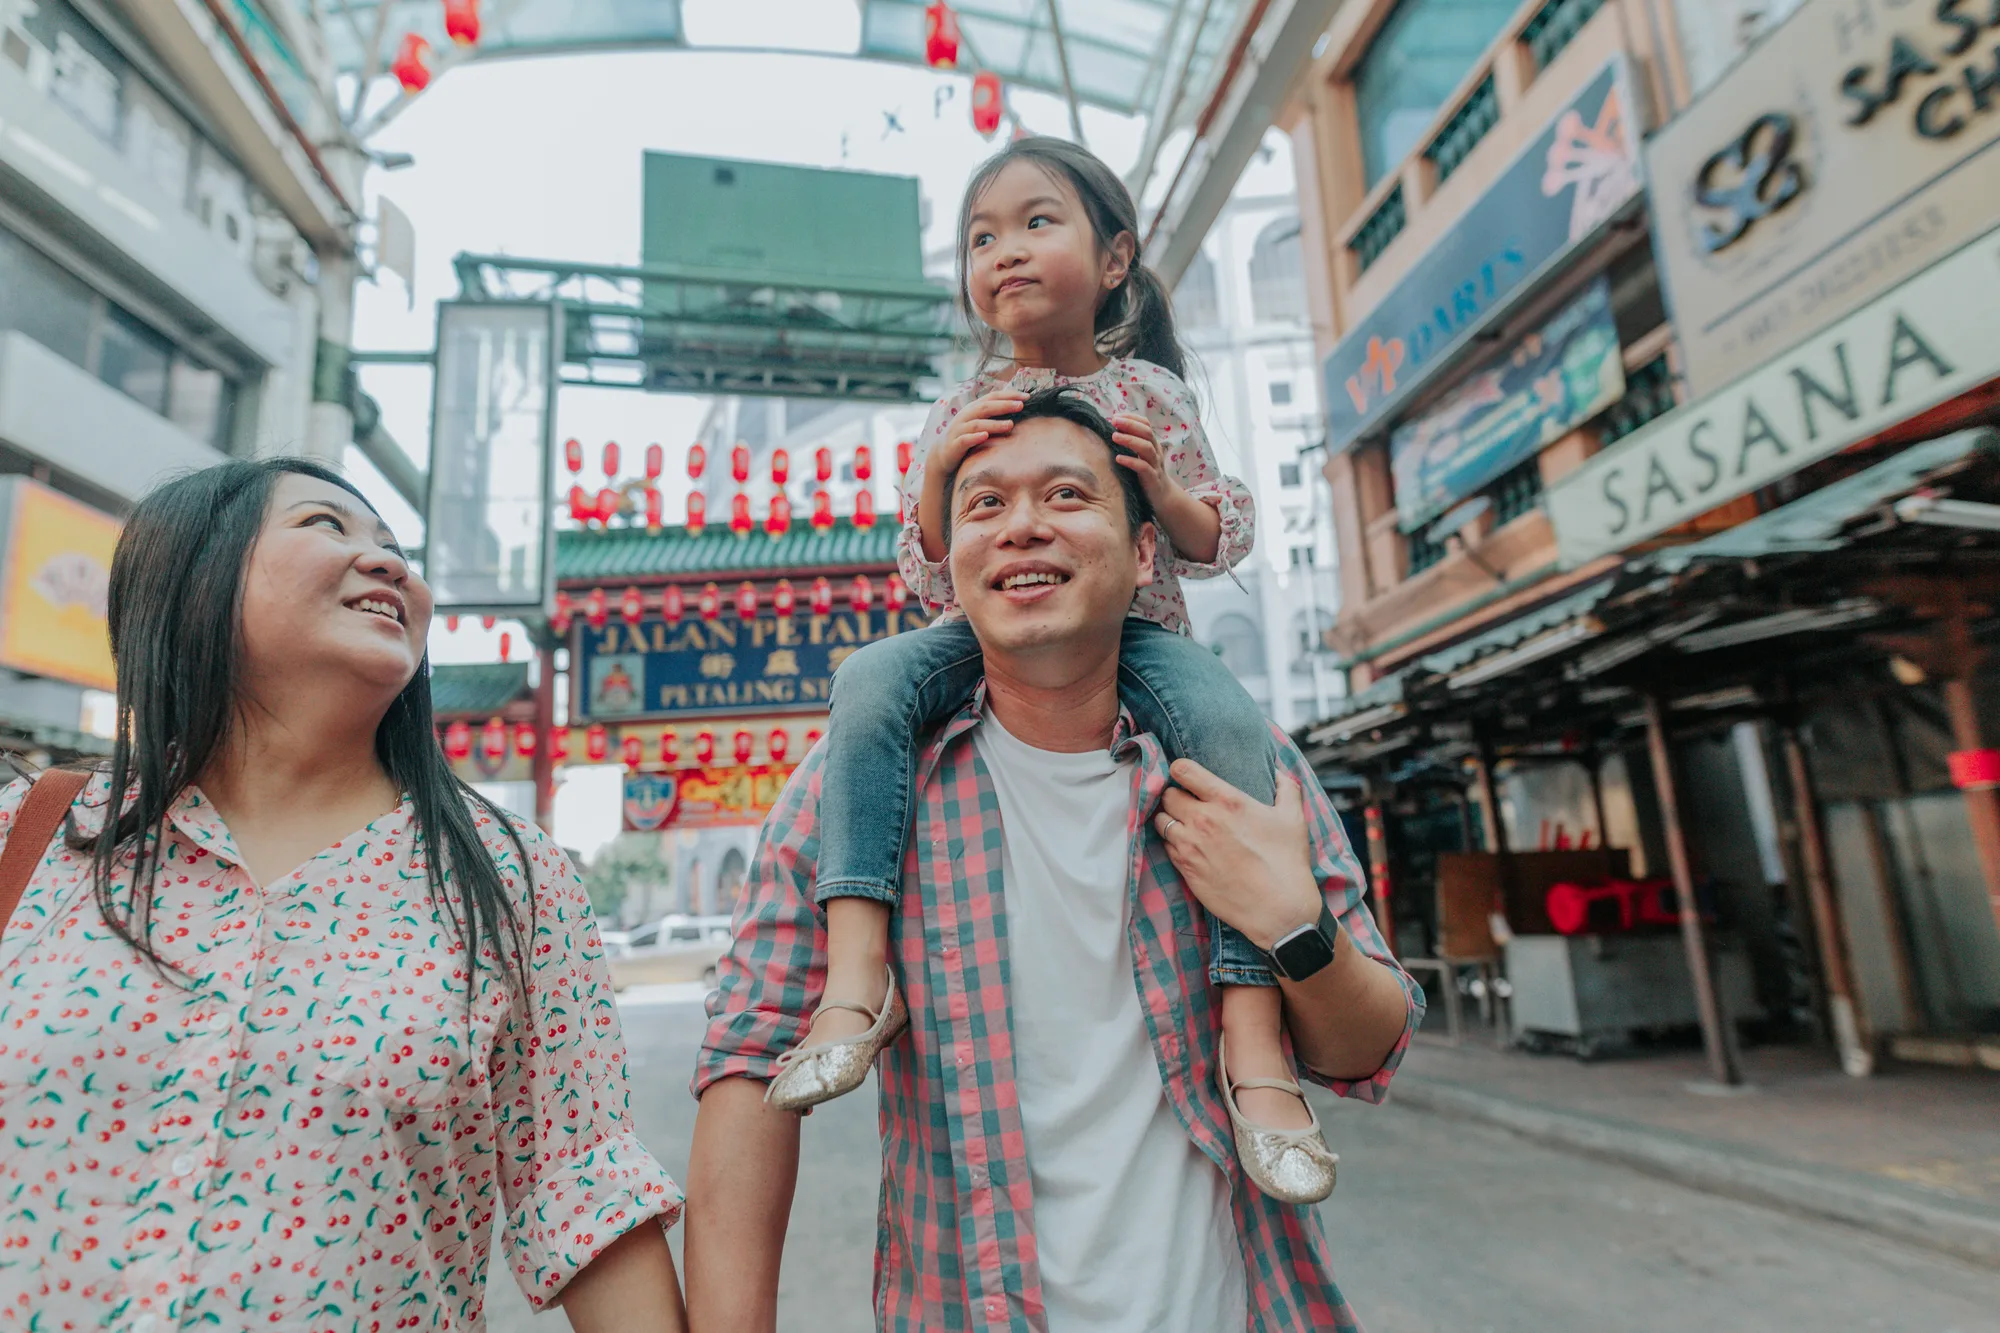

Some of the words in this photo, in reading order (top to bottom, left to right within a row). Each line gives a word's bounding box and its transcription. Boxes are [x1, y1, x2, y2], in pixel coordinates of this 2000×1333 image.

[1603, 313, 1954, 536] SASANA
[596, 618, 737, 653] JALAN
[661, 677, 796, 709] PETALING
